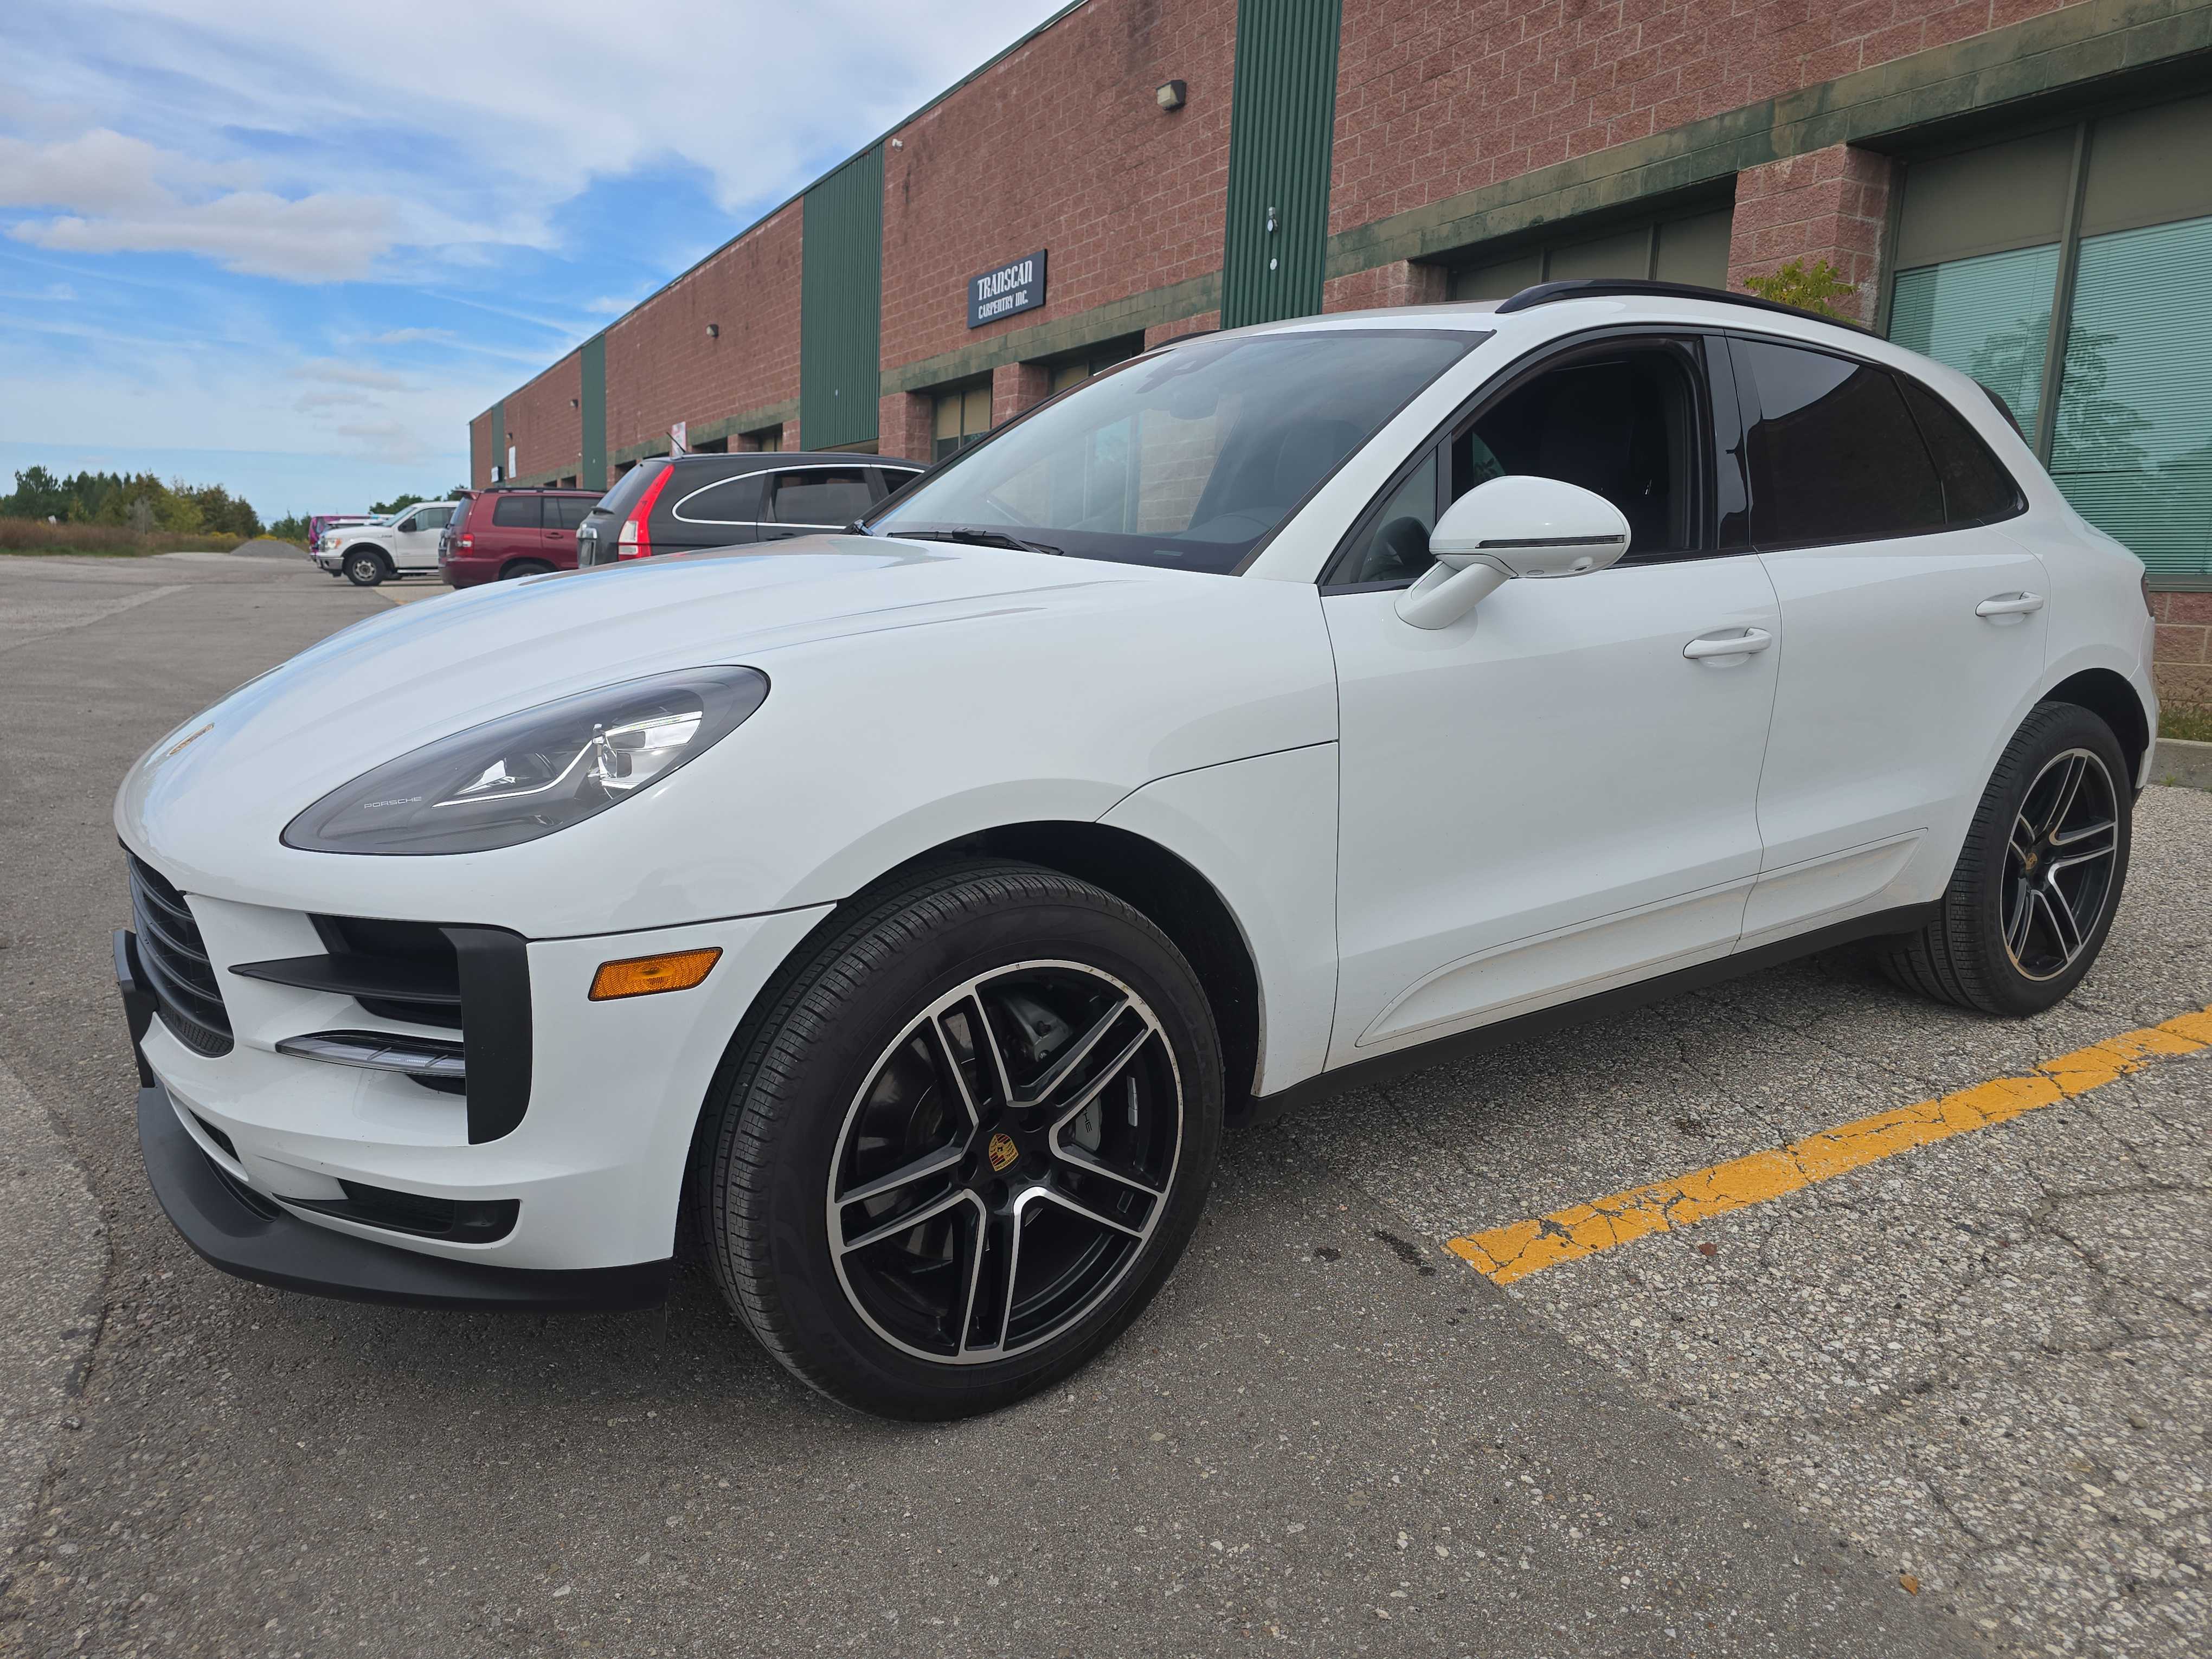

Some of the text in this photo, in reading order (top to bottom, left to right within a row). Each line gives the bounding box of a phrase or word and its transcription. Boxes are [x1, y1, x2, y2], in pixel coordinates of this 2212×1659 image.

[978, 260, 1032, 300] TRANSCAN
[978, 290, 1028, 319] CARPENTRY INC.
[364, 796, 422, 808] PORSCHE
